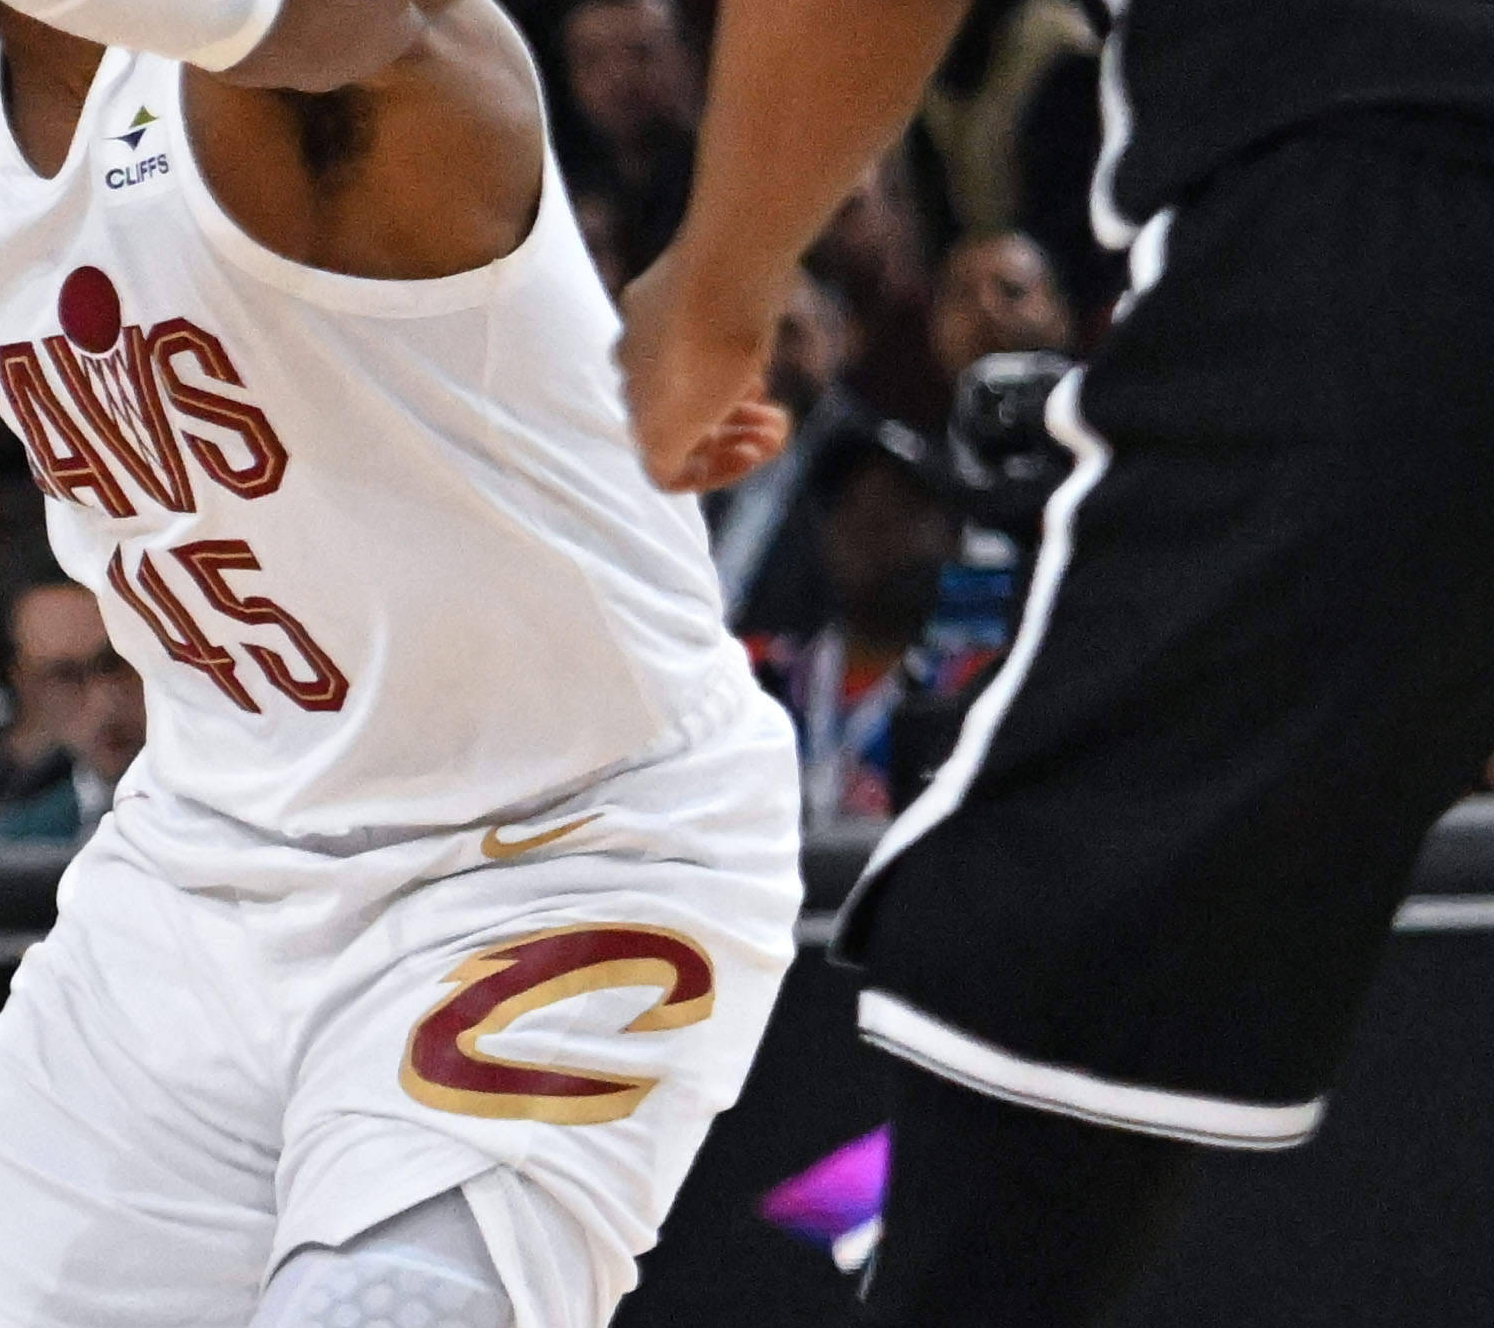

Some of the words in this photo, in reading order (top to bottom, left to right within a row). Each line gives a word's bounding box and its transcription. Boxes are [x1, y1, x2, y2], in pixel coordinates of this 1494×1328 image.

[105, 153, 169, 189] CLIFFS
[106, 539, 349, 714] 45
[398, 922, 715, 1125] C
